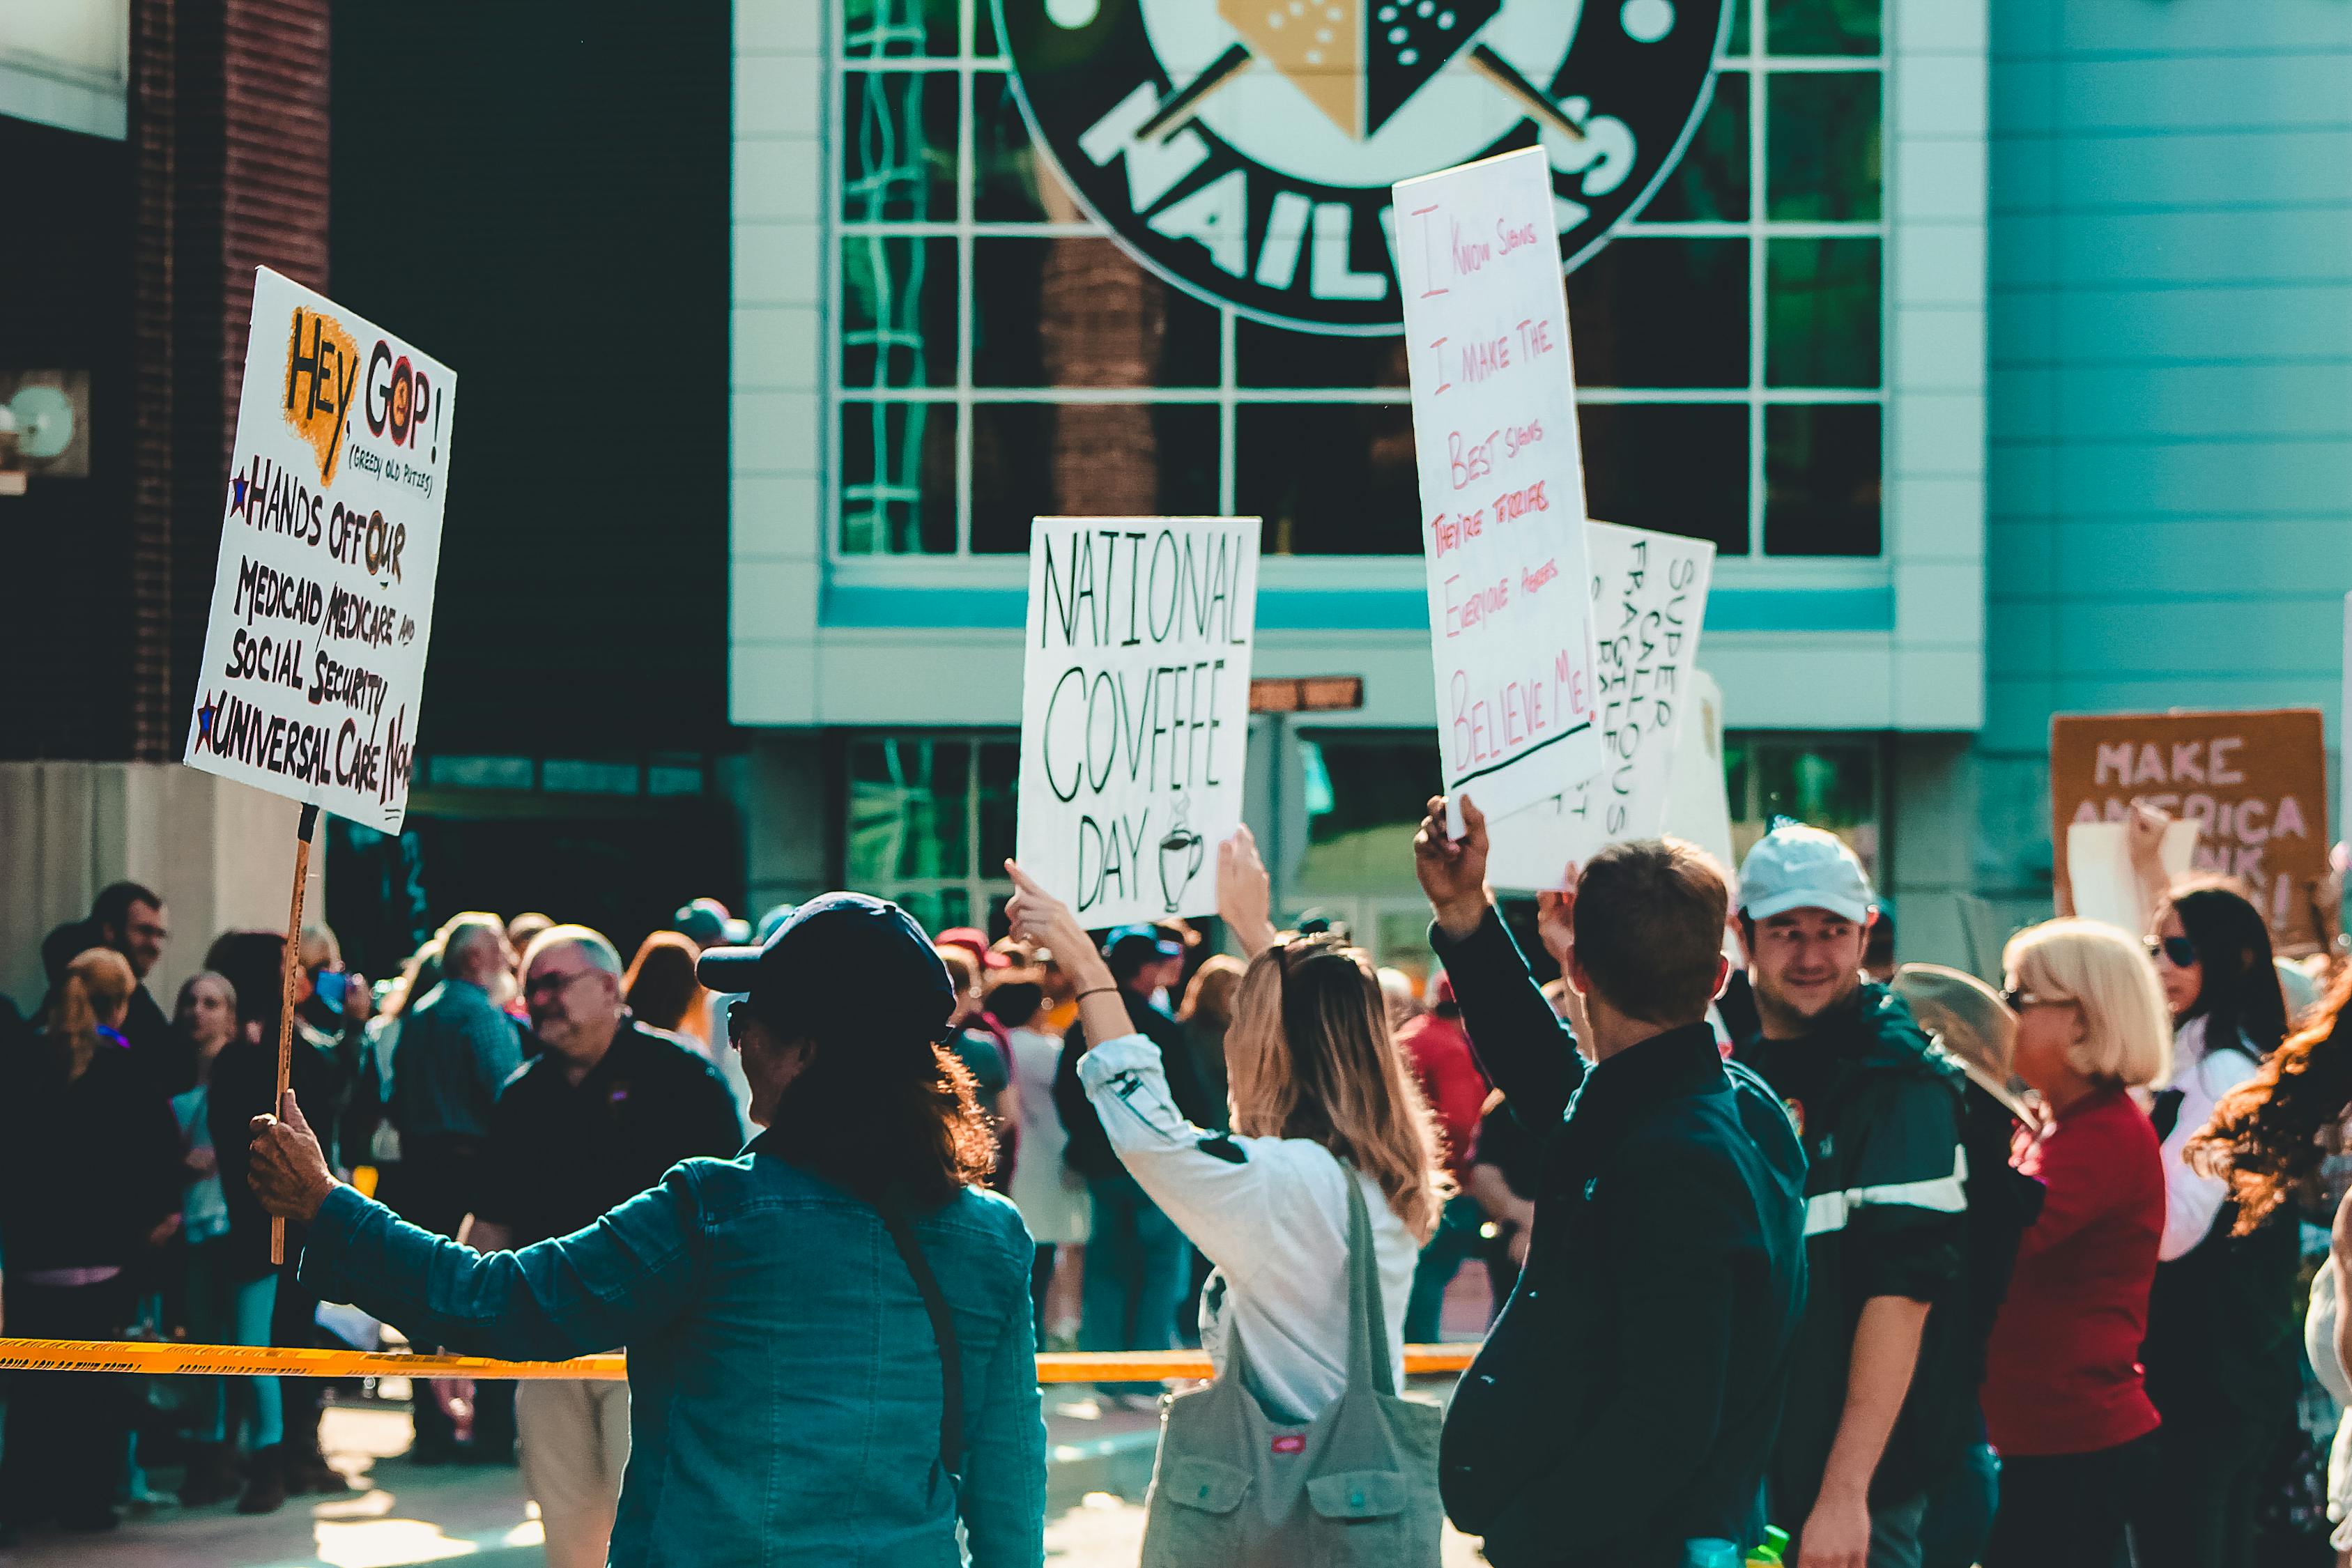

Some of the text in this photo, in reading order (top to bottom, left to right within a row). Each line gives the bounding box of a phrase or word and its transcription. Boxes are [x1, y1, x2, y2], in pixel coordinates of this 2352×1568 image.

[1077, 78, 1638, 302] NAILS
[1411, 204, 1450, 298] I
[366, 340, 441, 465] GOP!
[1430, 319, 1553, 395] I MAKE THE
[246, 454, 406, 584] HANDS OFF OUR
[385, 459, 401, 482] OLD
[1448, 430, 1500, 490] BEST
[1043, 530, 1246, 649] NATIONAL
[1604, 540, 1646, 753] FRAGILE
[1647, 558, 1694, 733] SUPER
[212, 690, 331, 787] UNIVERSAL
[335, 717, 381, 794] CARE
[225, 628, 388, 746] SOCIAL SECURITY
[1044, 659, 1224, 802] COVFEFE
[1450, 669, 1546, 771] BELIEVE
[1606, 610, 1661, 835] CALLOUS
[2094, 736, 2246, 786] MAKE
[1077, 806, 1149, 912] DAY
